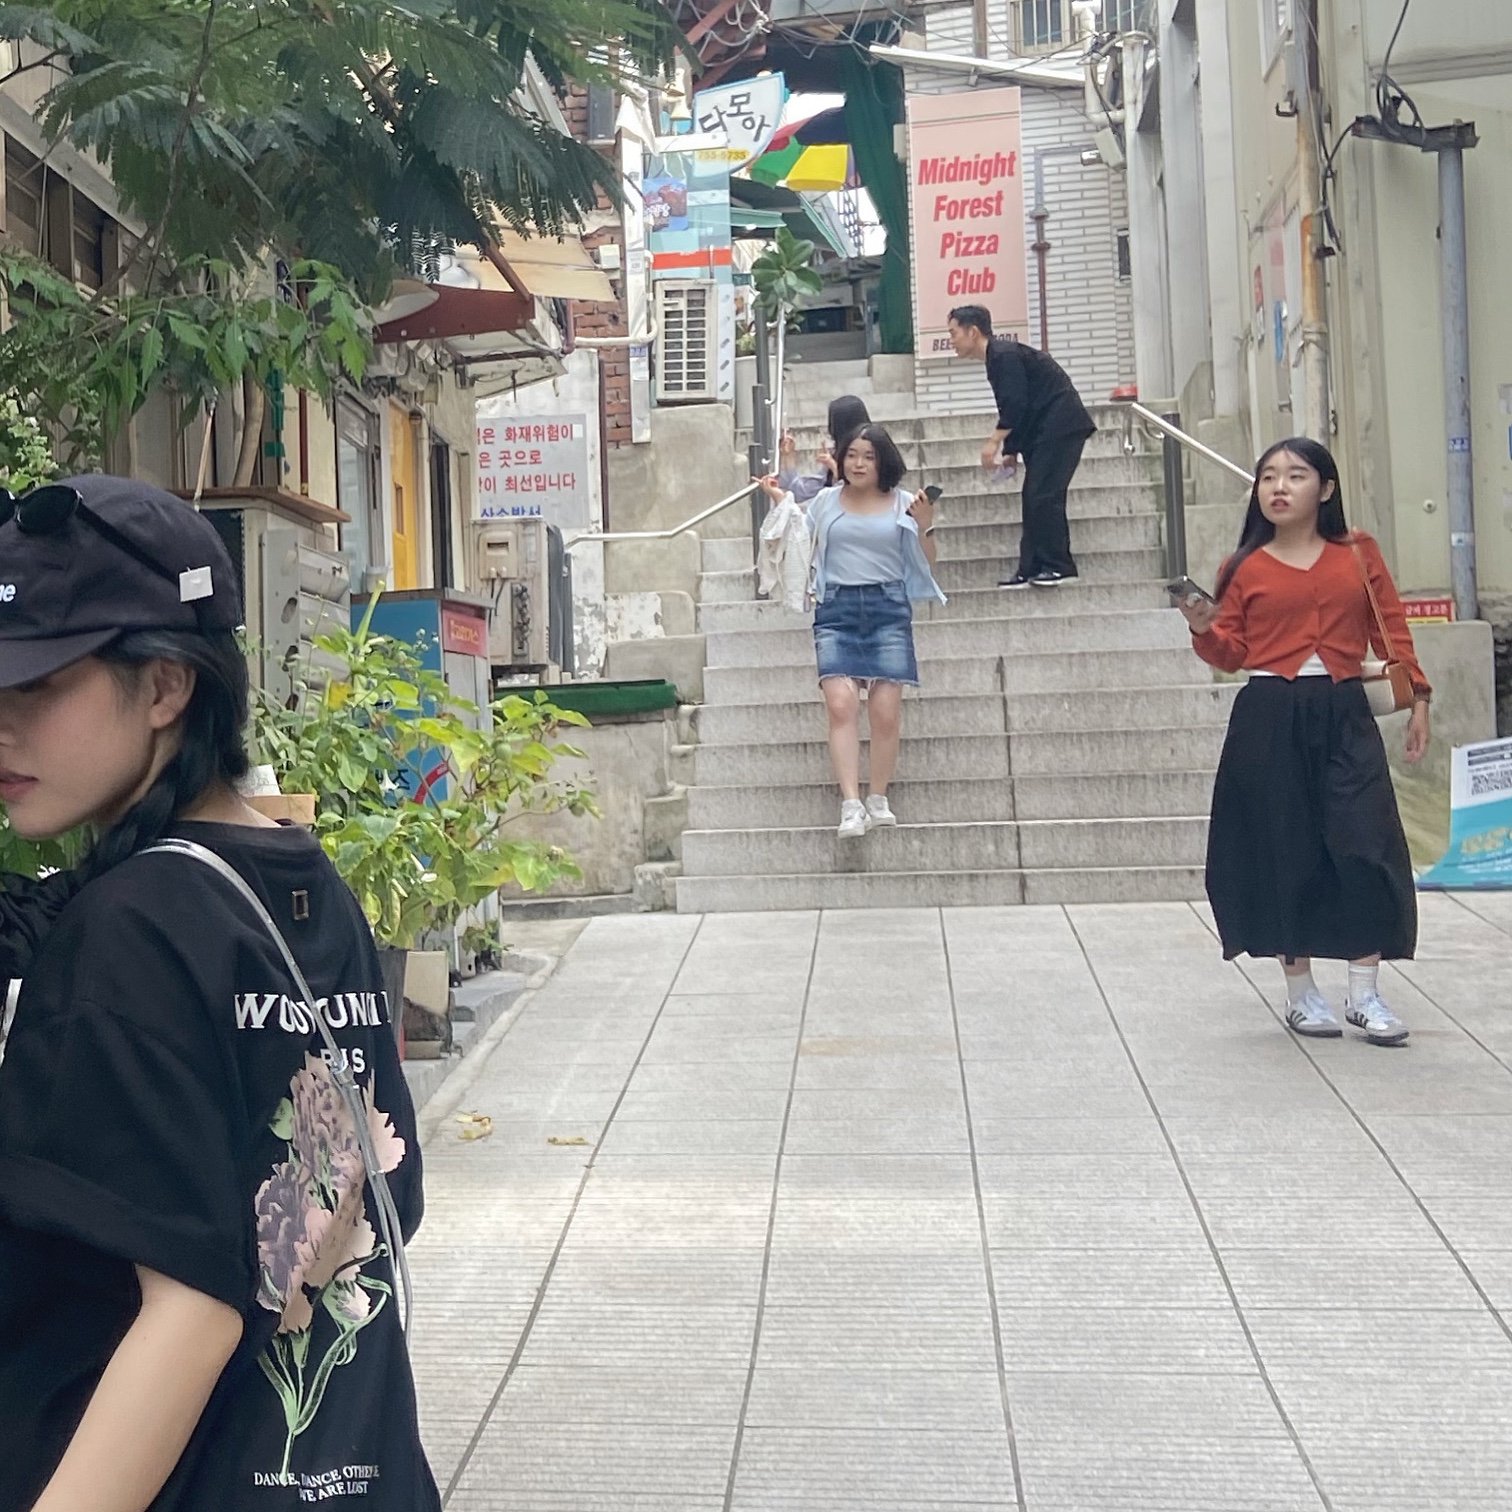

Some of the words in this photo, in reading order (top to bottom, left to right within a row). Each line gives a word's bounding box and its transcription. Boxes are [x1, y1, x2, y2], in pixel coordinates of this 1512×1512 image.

[697, 91, 772, 142] 다모아
[918, 151, 1017, 186] Midnight
[933, 190, 1004, 222] Forest
[939, 231, 1000, 259] Pizza
[946, 267, 996, 296] Club
[932, 338, 954, 352] BEE
[477, 427, 495, 445] 은
[504, 423, 574, 443] 화재위험이
[498, 450, 542, 468] 곳으로
[478, 476, 496, 494] 이
[504, 473, 576, 494] 최선입니다
[302, 1469, 342, 1488] DANCE
[299, 1488, 317, 1502] WE
[318, 1482, 347, 1500] ARE
[347, 1481, 369, 1495] LOST
